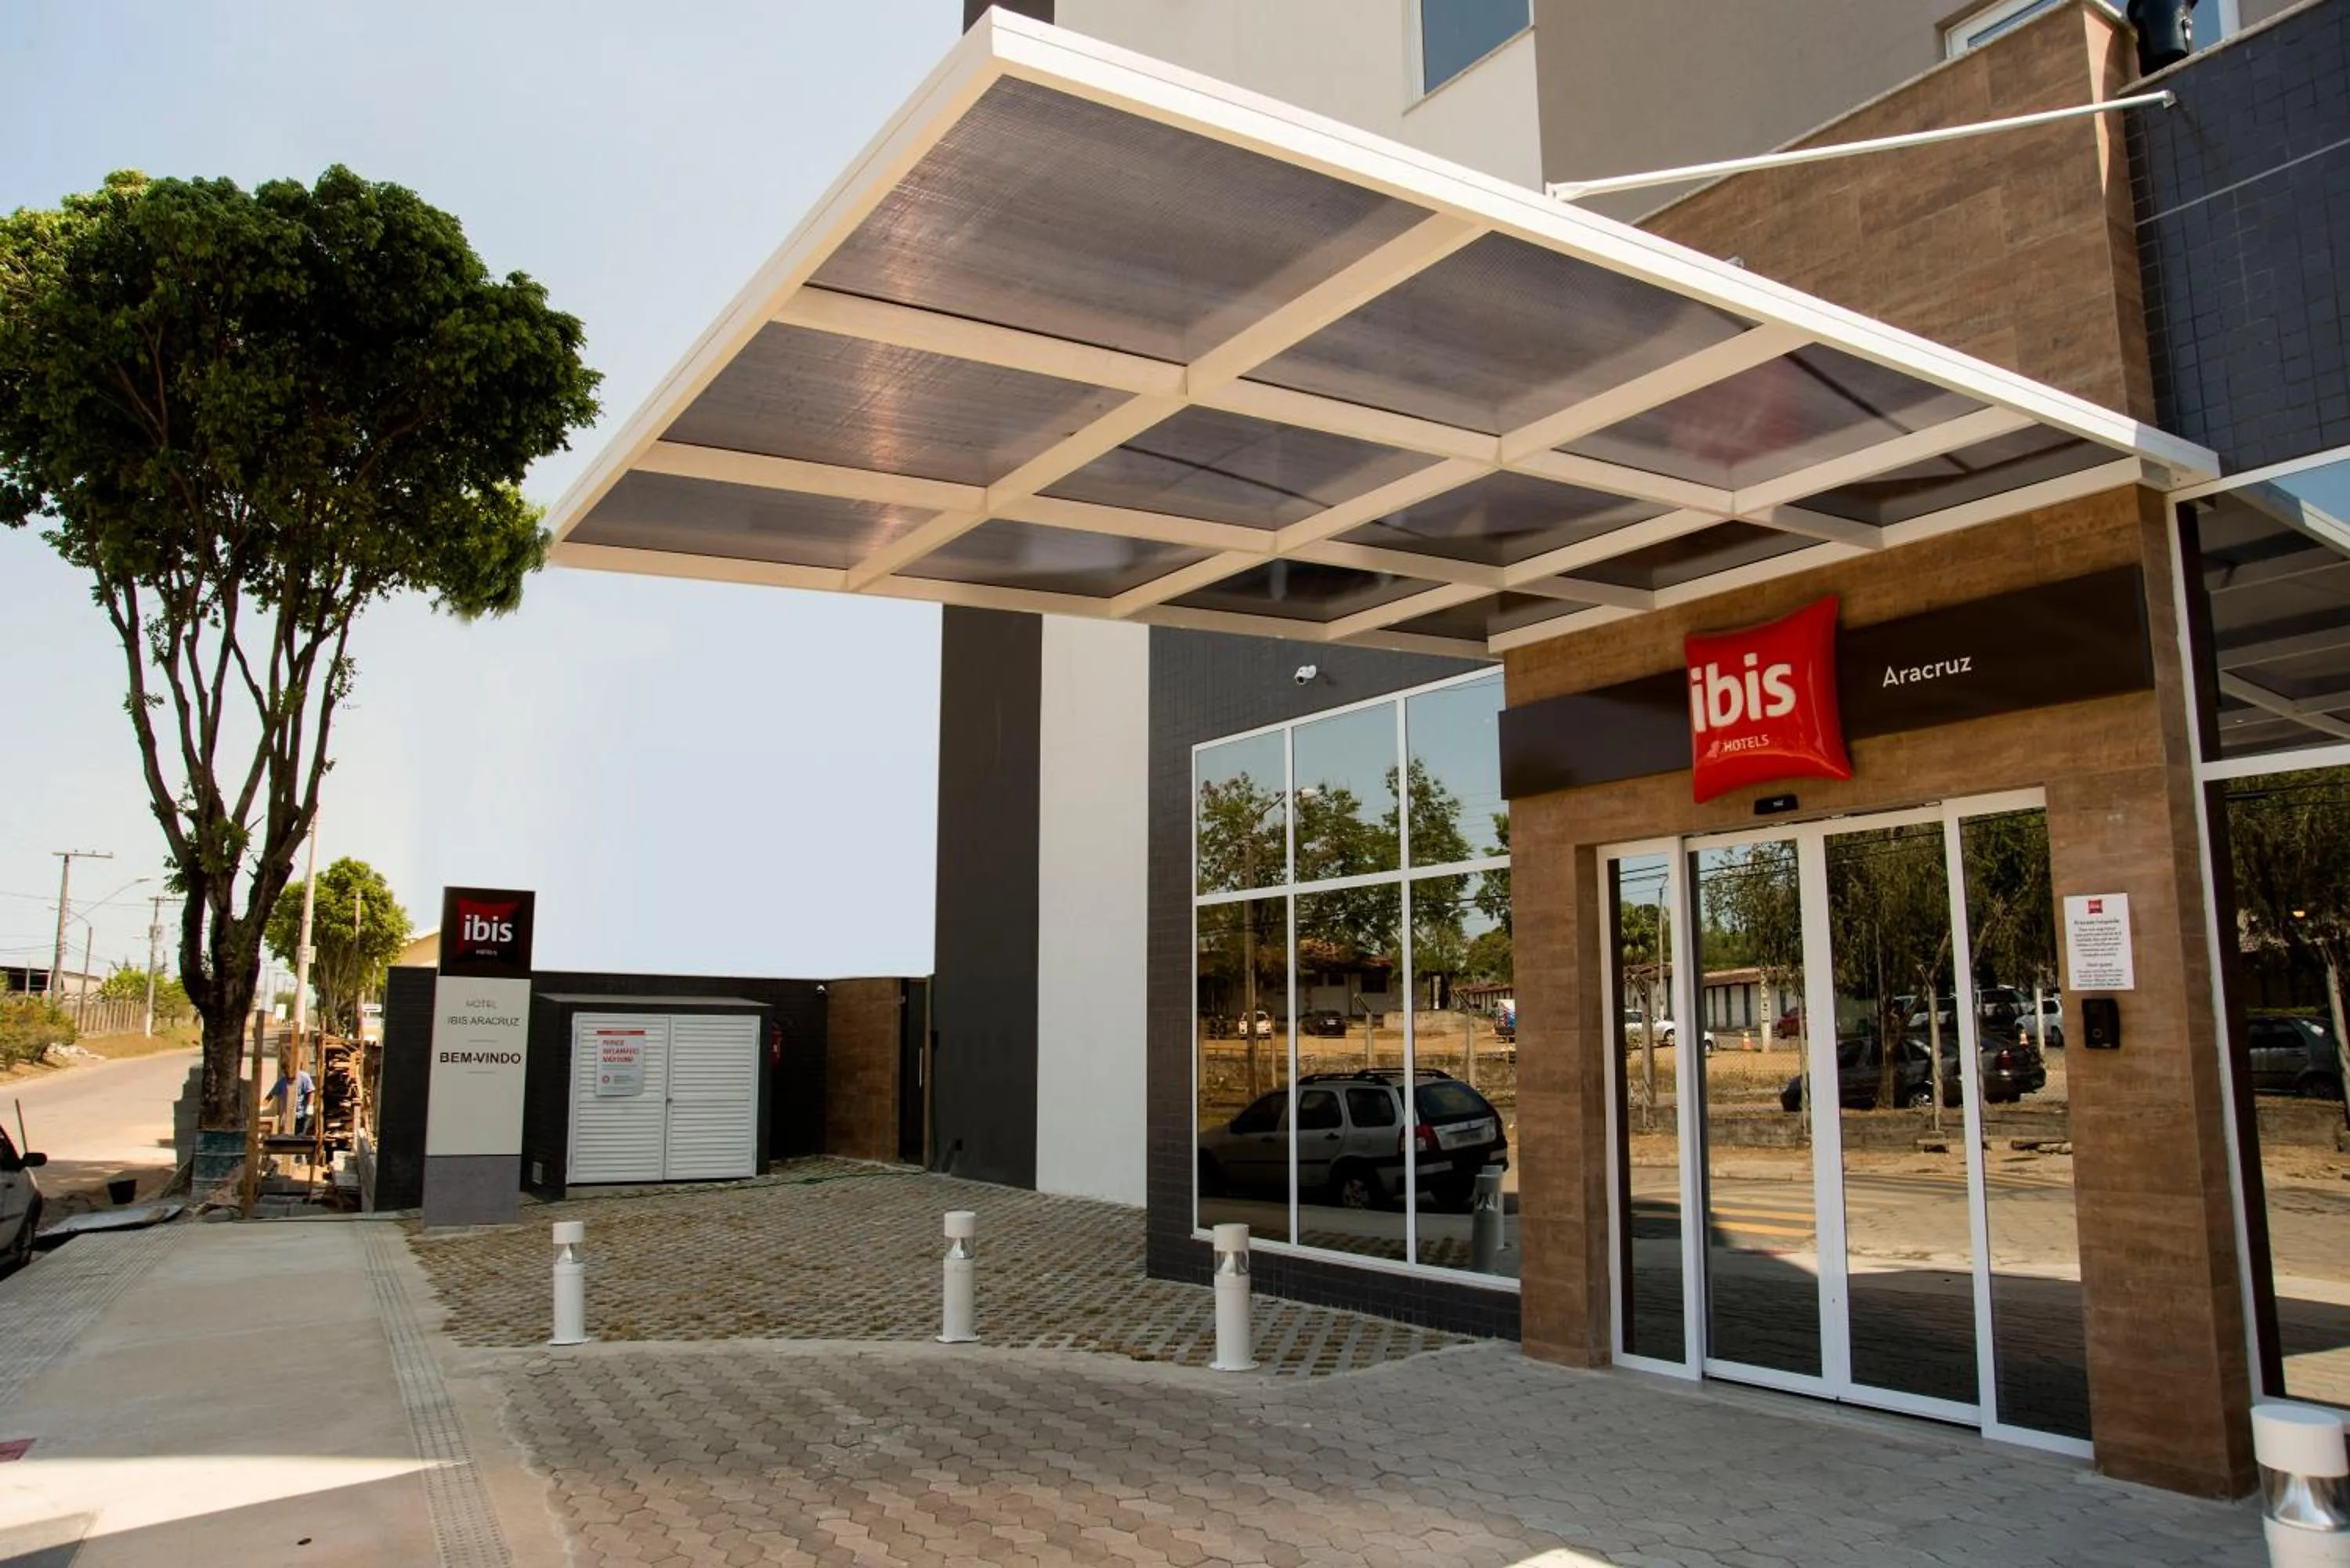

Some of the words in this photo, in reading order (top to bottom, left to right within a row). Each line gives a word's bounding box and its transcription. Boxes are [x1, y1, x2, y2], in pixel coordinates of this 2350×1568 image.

[1882, 656, 1972, 688] Aracruz
[1690, 652, 1796, 732] ibis
[1723, 734, 1770, 753] HOTELS
[464, 914, 513, 942] ibis
[447, 1016, 468, 1025] IBIS
[470, 1017, 520, 1027] ARACRUZ
[439, 1052, 522, 1064] BEM-VINDO
